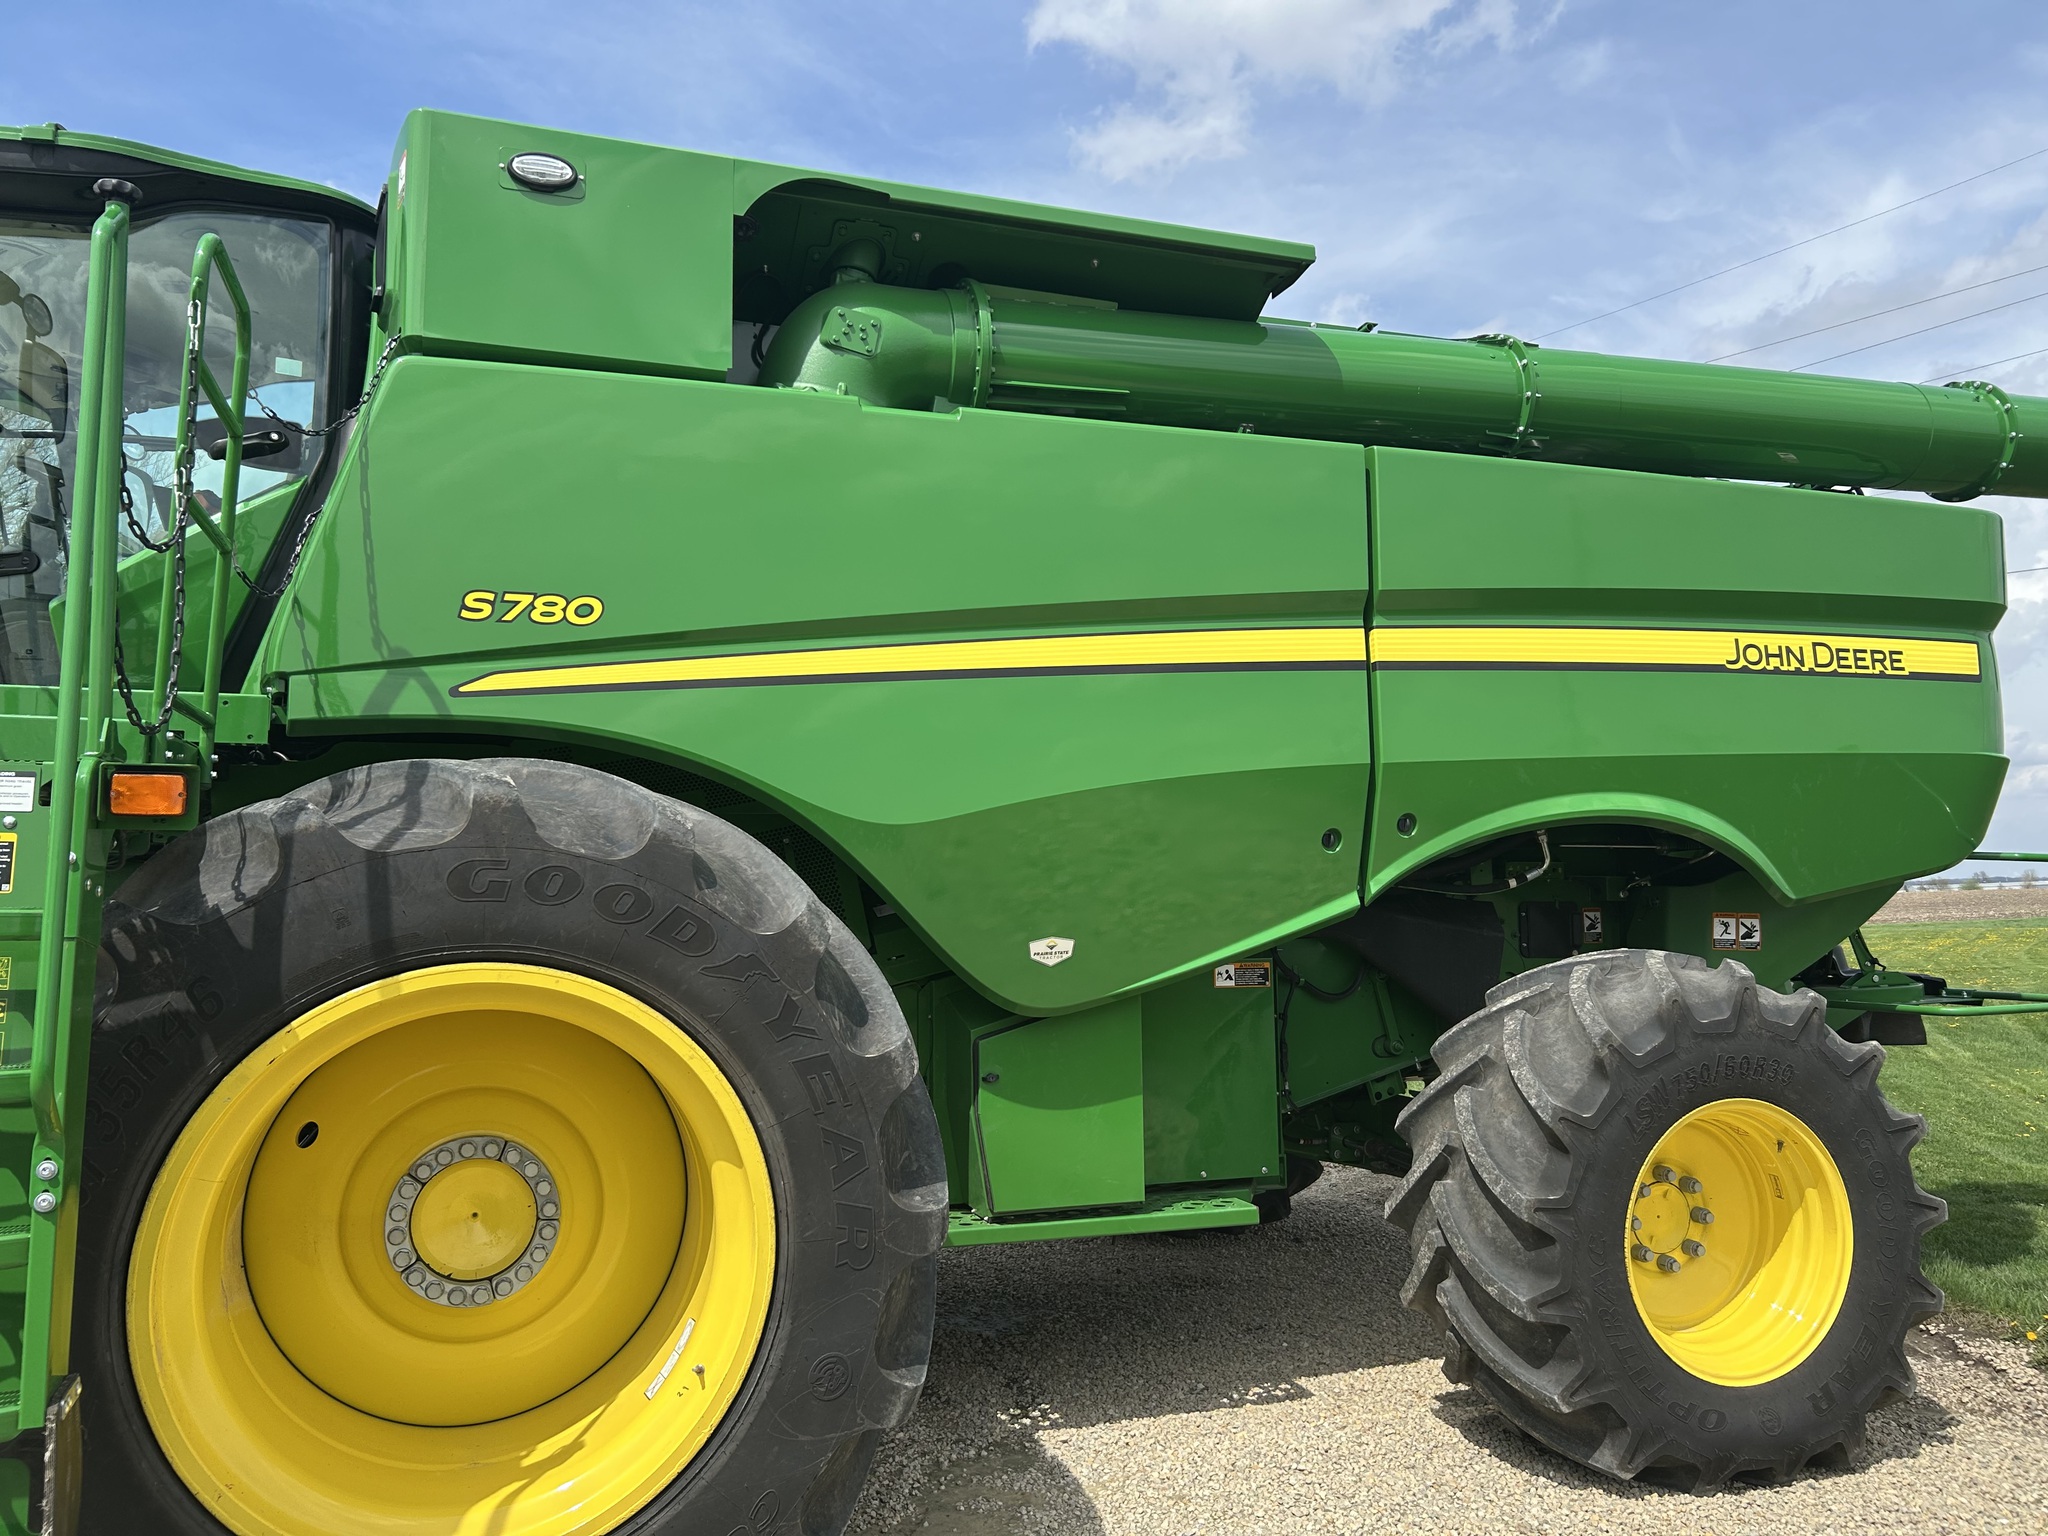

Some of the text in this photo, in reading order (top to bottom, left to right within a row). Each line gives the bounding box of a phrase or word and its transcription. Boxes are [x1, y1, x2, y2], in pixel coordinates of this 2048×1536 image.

[457, 589, 605, 627] S780
[1725, 637, 1906, 672] JOHN DEERE
[446, 858, 876, 1270] GOODYEAR
[1588, 1232, 1729, 1433] OPTITRAC
[1805, 1127, 1899, 1418] GOODYEAR
